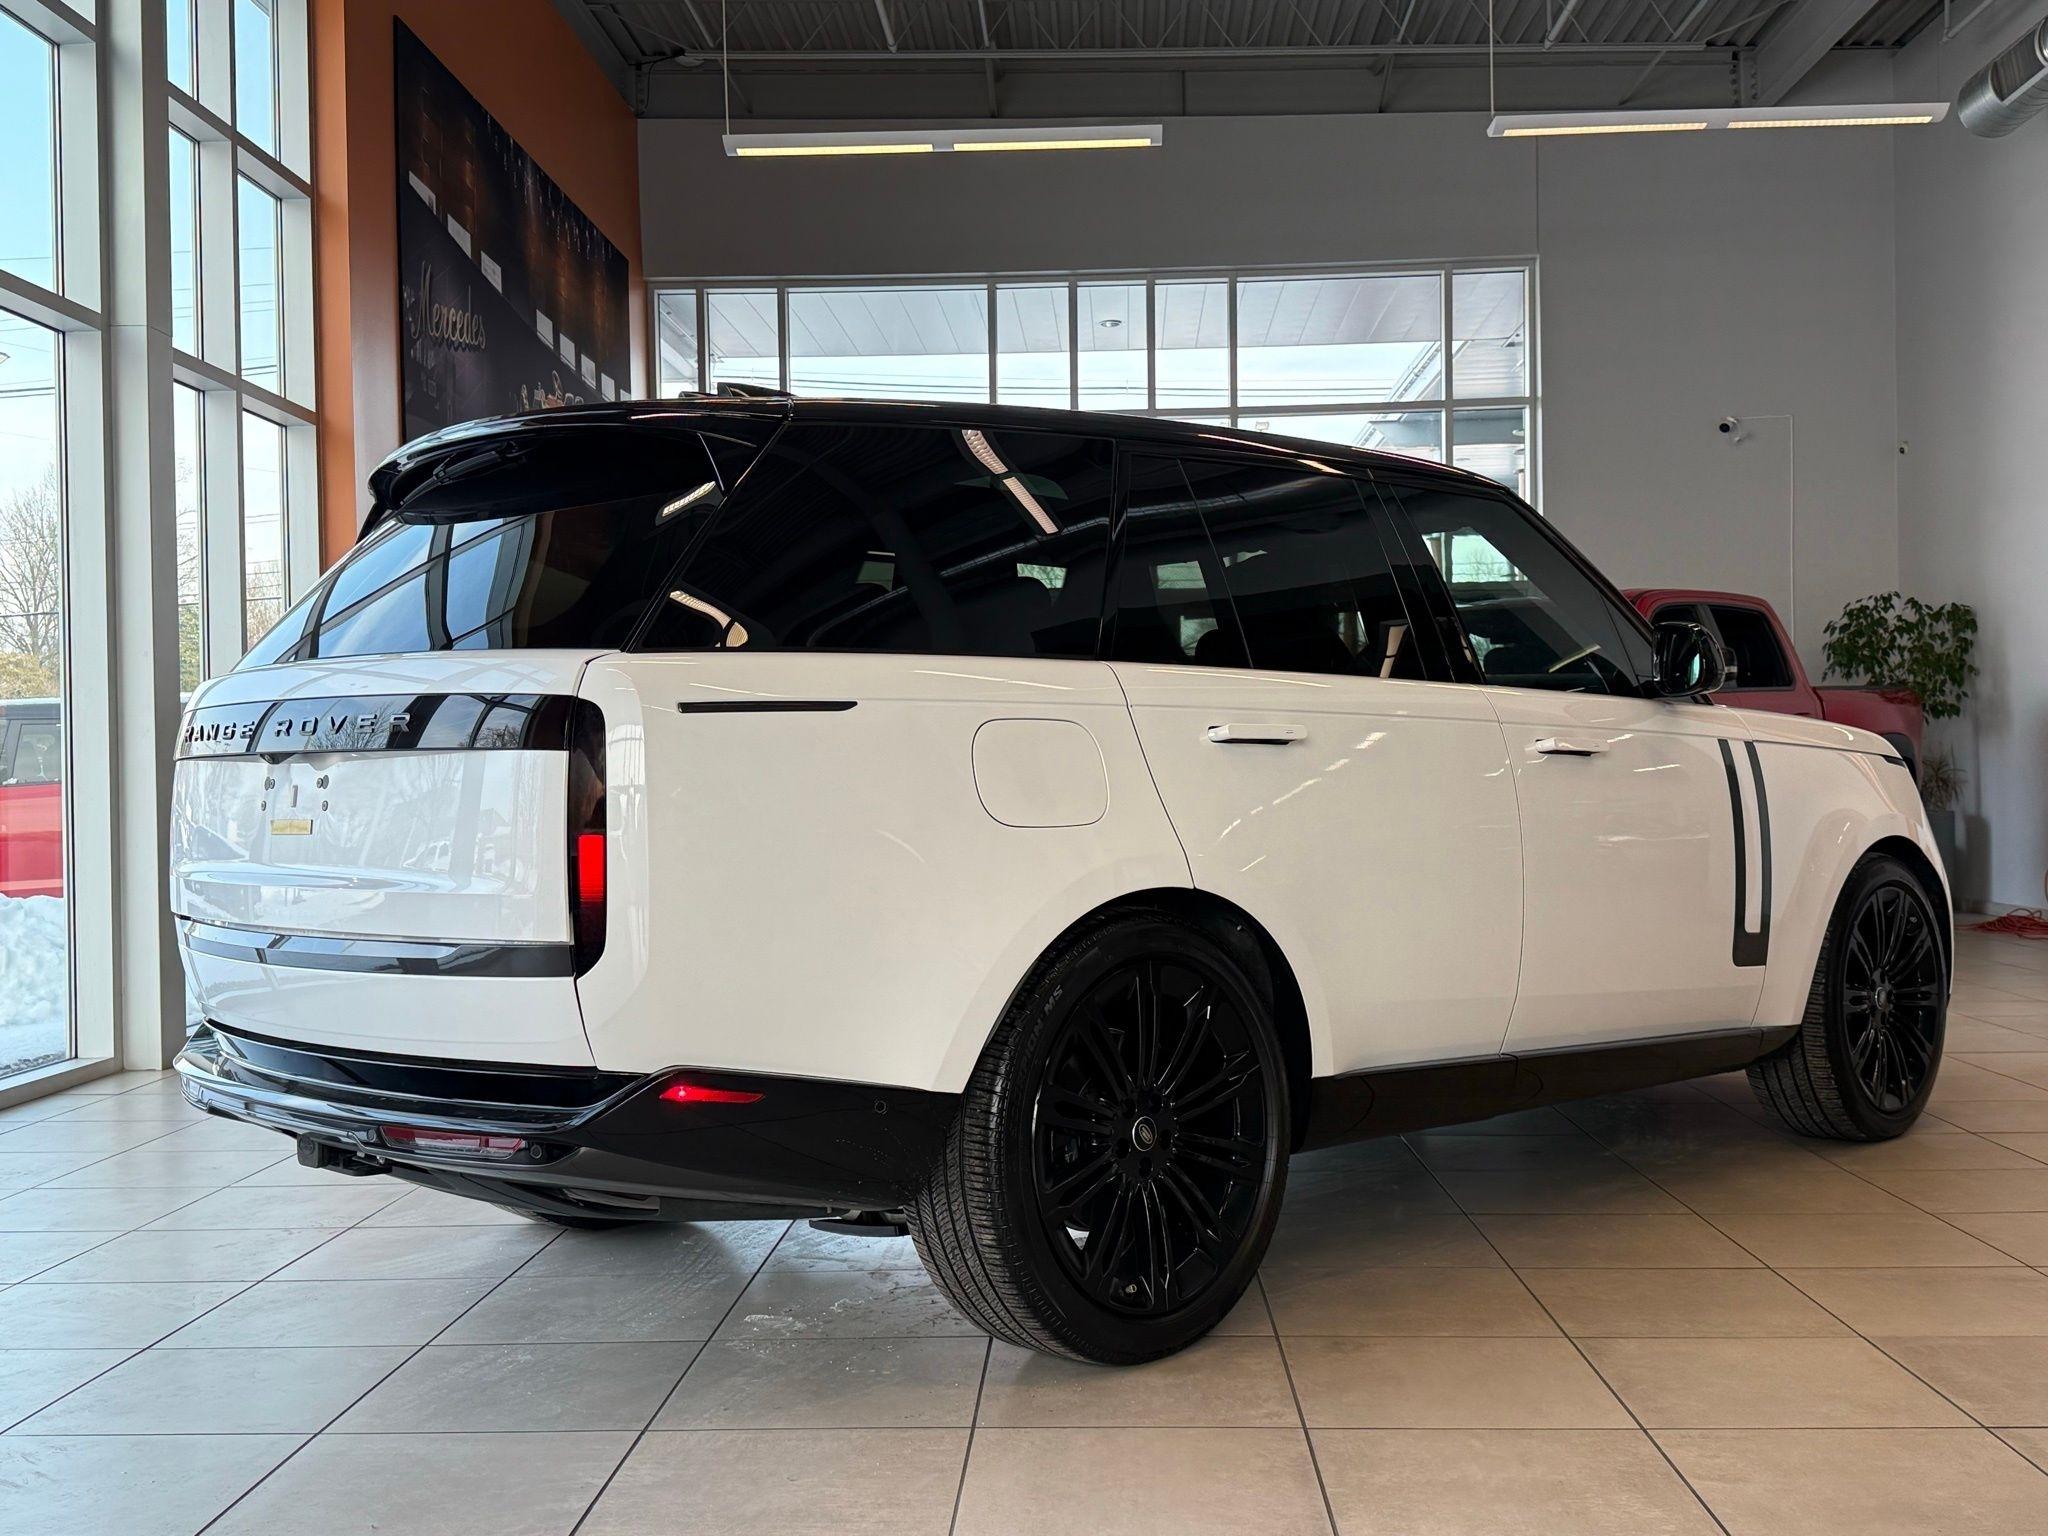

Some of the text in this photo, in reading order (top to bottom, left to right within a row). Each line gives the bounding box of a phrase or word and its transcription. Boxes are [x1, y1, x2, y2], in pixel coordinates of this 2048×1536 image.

[412, 260, 486, 349] Mercedes
[185, 713, 411, 743] RANGE ROVER
